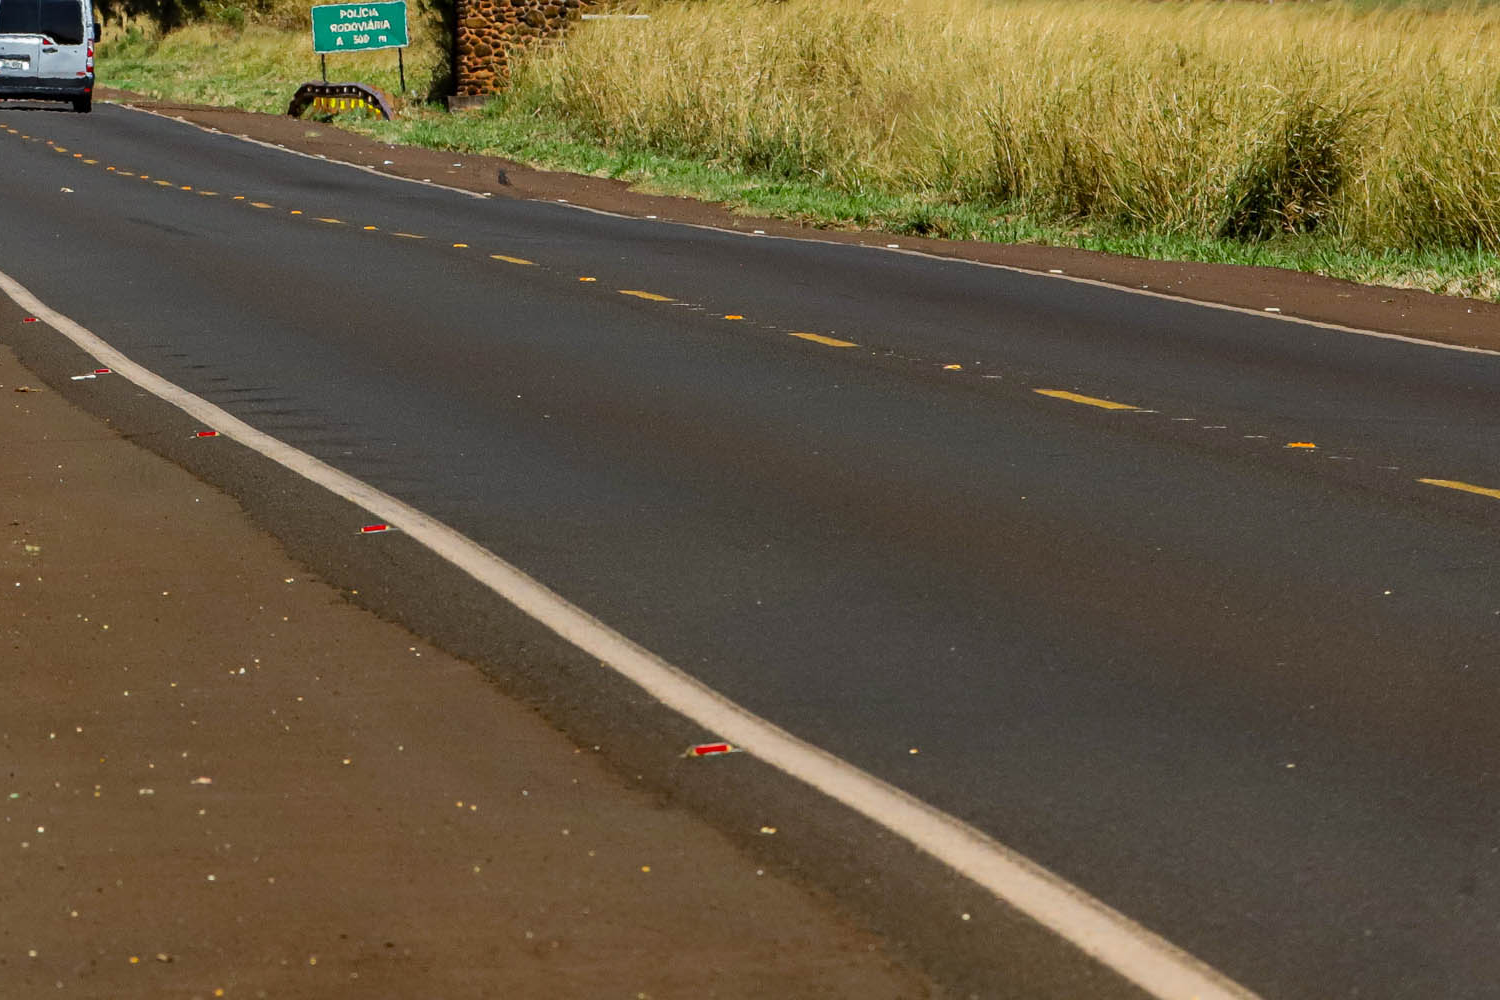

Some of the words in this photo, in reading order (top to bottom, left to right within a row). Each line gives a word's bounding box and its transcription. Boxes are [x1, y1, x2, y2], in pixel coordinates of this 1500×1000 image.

[340, 7, 379, 18] POLÍCIA
[330, 19, 391, 33] RODOVIÁRIA
[336, 36, 344, 46] A
